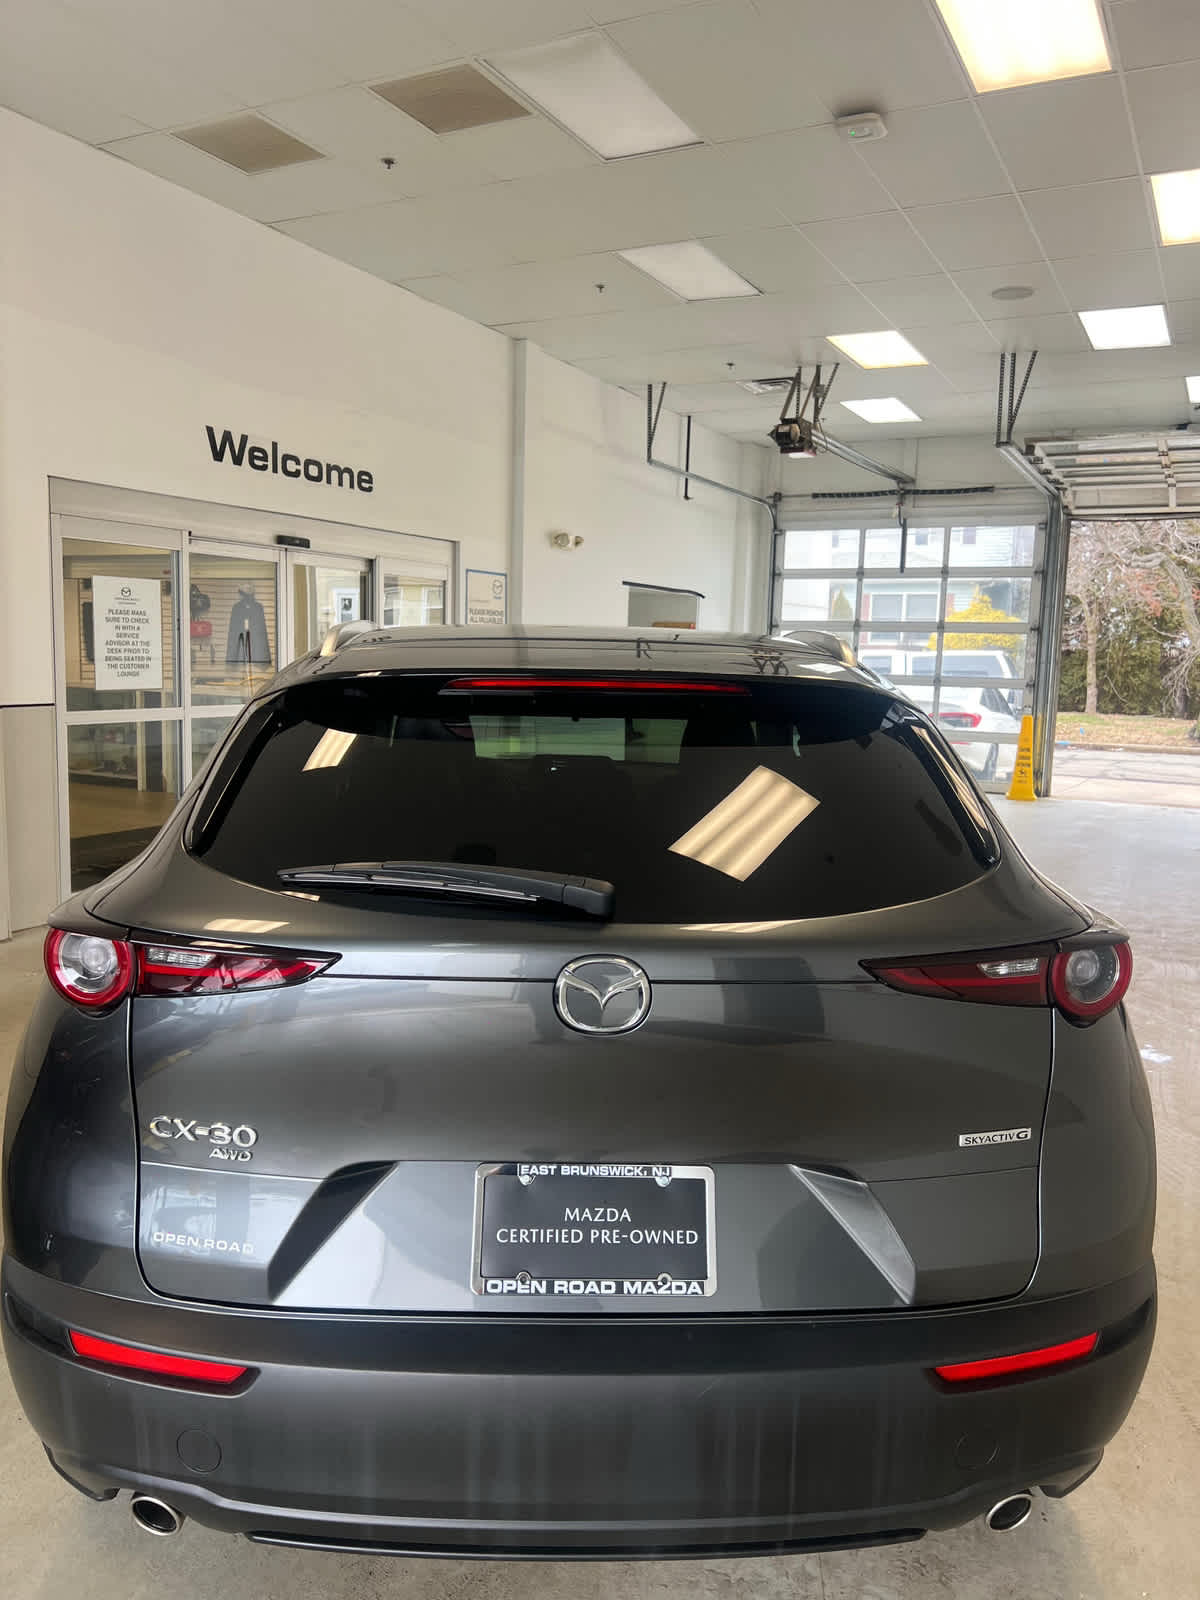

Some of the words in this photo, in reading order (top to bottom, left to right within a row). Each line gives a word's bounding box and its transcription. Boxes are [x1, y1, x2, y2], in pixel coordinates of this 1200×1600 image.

[206, 425, 373, 492] Welcome
[107, 608, 130, 616] PLEASE
[149, 1115, 258, 1148] CX-30
[209, 1147, 253, 1162] AWD
[520, 1165, 557, 1176] EAST
[651, 1166, 671, 1177] NJ
[564, 1207, 632, 1222] MAZDA
[152, 1231, 200, 1247] OPEN
[203, 1239, 254, 1255] ROAD
[496, 1228, 584, 1244] CERTIFIED
[590, 1229, 698, 1245] PRE-OWNED
[486, 1279, 547, 1295] OPEN
[553, 1279, 616, 1295] ROAD
